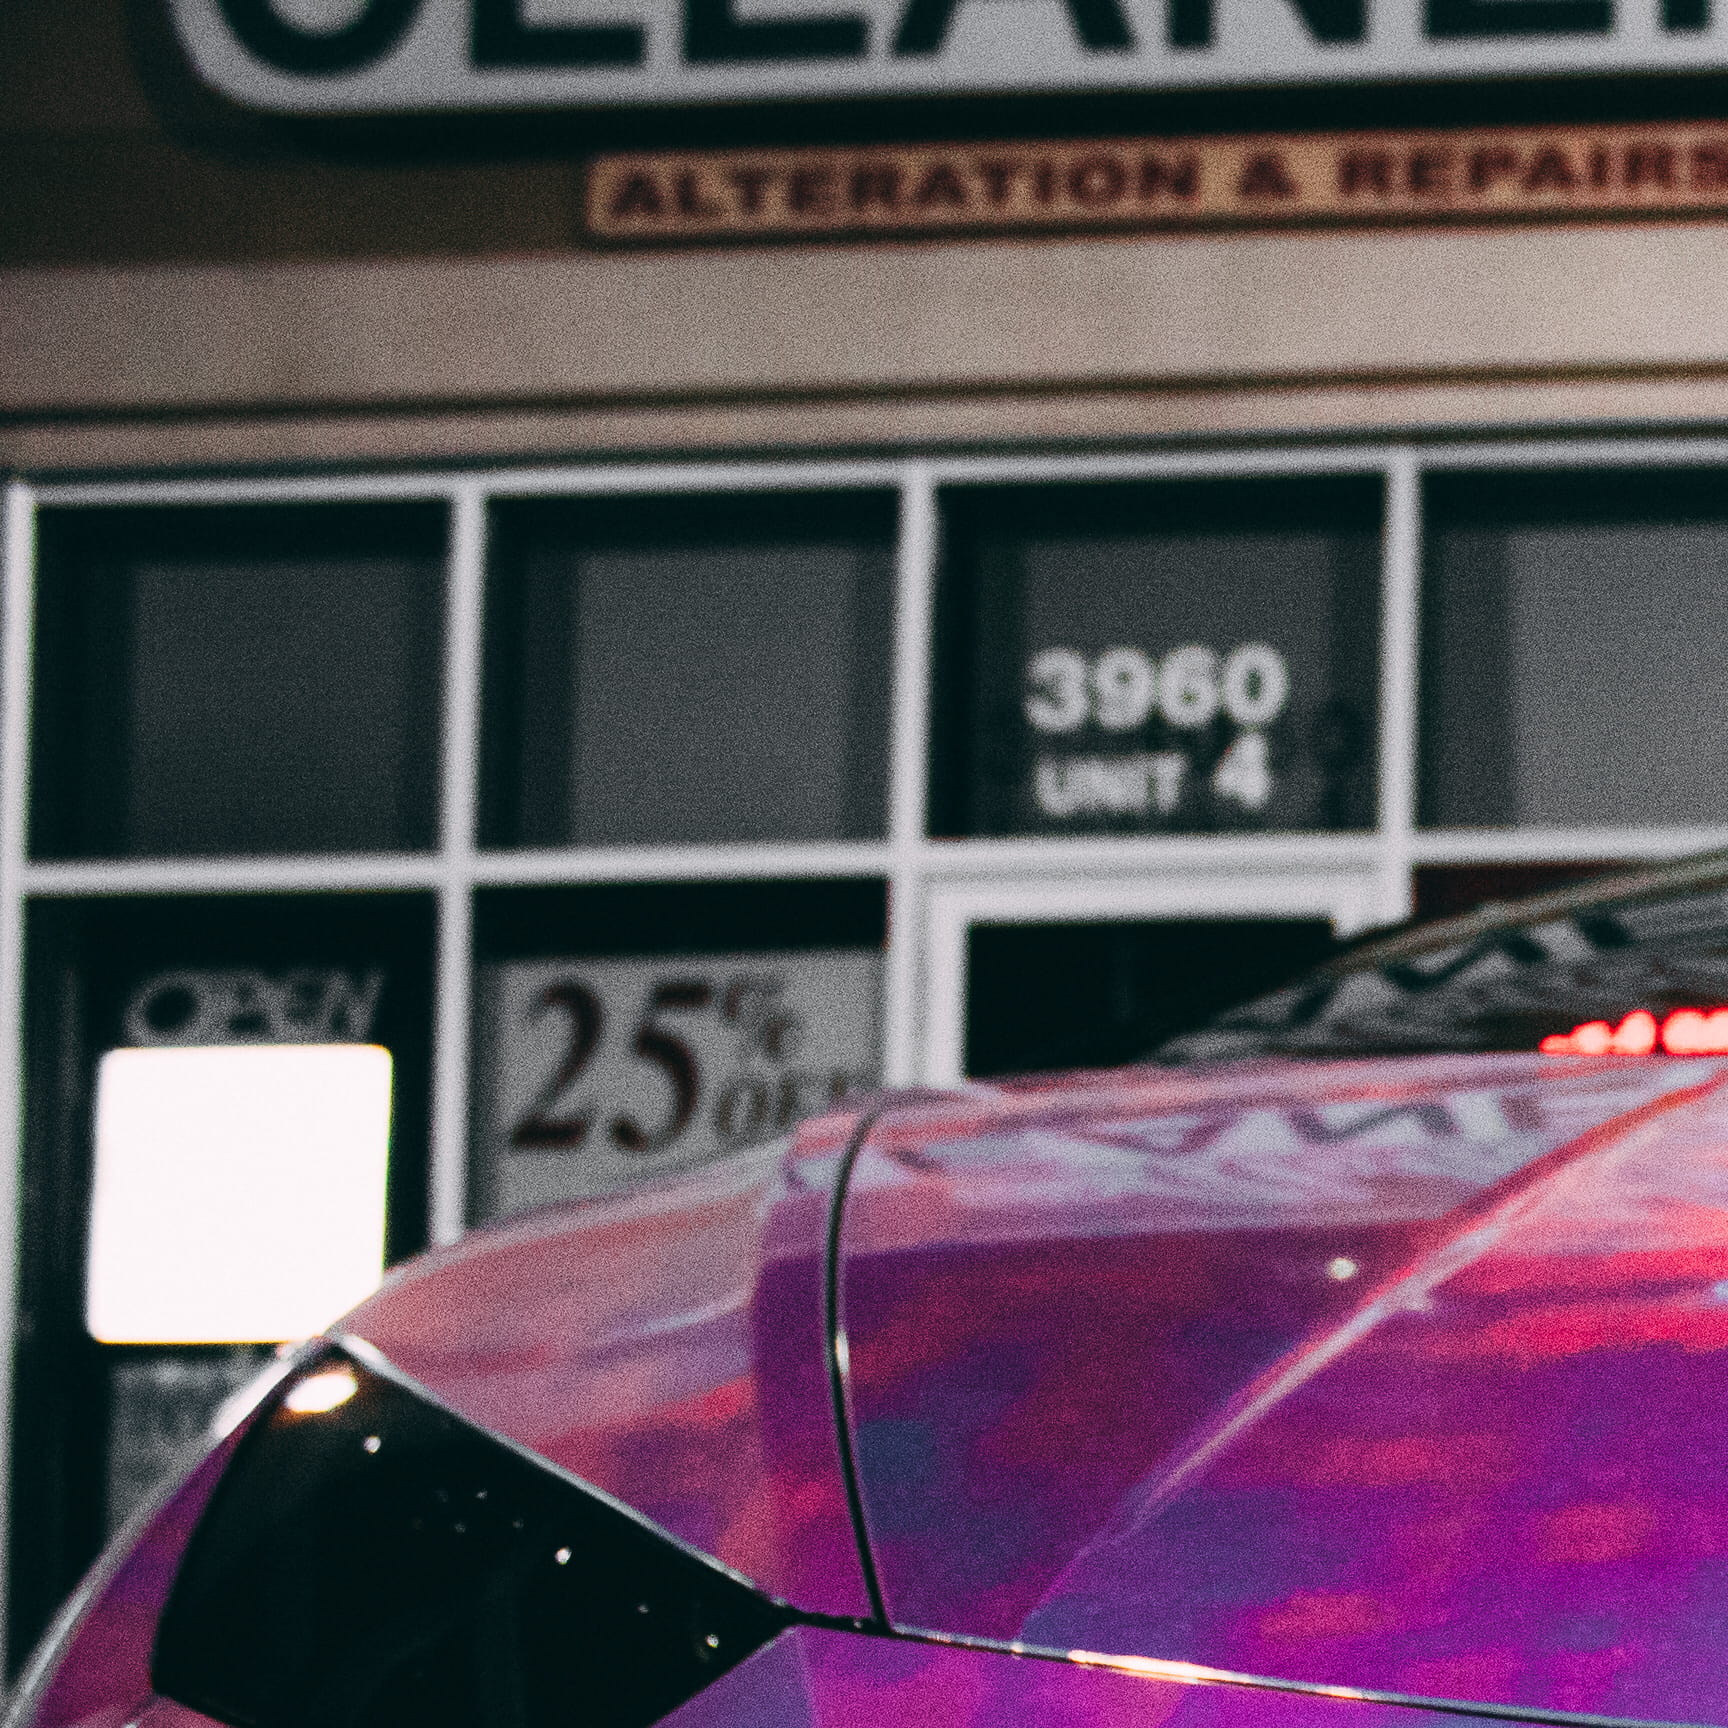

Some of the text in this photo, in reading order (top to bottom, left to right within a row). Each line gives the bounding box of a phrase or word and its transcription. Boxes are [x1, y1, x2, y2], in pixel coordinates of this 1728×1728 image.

[606, 150, 1200, 222] ALTERATION
[1238, 153, 1297, 203] &
[1025, 644, 1288, 732] 3960
[1036, 732, 1272, 816] UNIT 4
